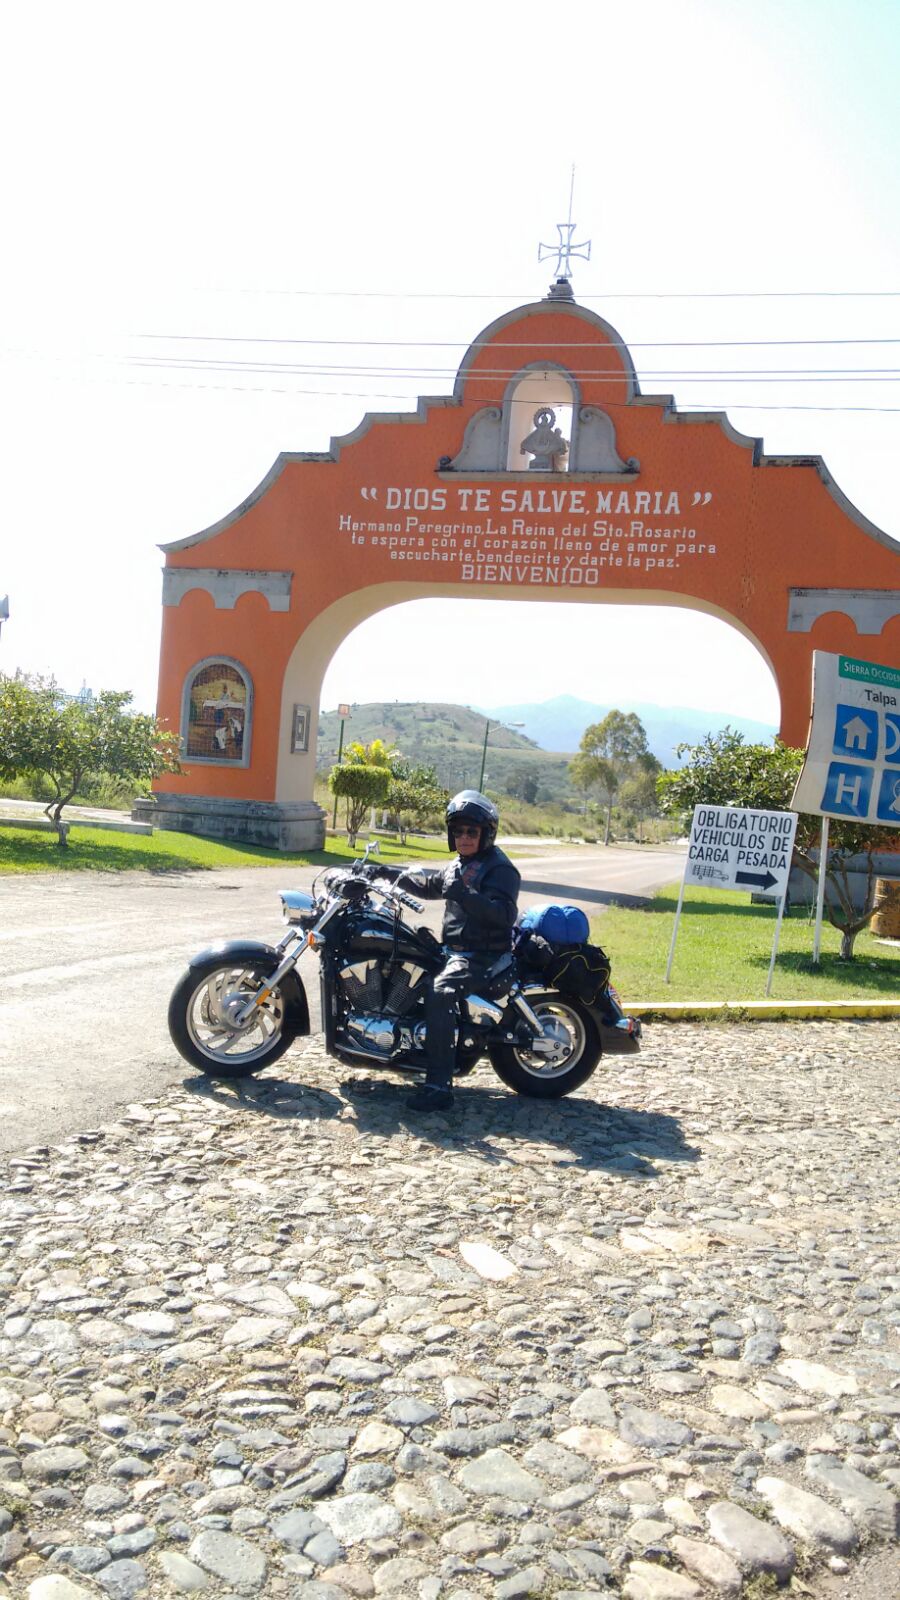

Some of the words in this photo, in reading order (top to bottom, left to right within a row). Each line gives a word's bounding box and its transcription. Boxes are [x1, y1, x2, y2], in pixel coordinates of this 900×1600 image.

[458, 488, 491, 512] TE
[500, 489, 590, 515] SALVE,
[338, 514, 401, 533] Hermano
[511, 519, 555, 537] Reina
[561, 523, 587, 537] del
[351, 532, 365, 545] te
[371, 535, 425, 549] espera
[431, 537, 457, 548] con
[463, 535, 477, 548] el
[484, 537, 547, 550] corazón
[554, 537, 593, 551] lleno
[599, 538, 620, 551] de
[627, 542, 668, 553] amor
[675, 543, 717, 557] para
[565, 554, 575, 569] y
[579, 552, 622, 567] darte
[627, 553, 641, 567] la
[461, 564, 599, 585] BIENVENIDO
[864, 689, 897, 707] Talpa
[697, 810, 793, 834] OBLIGATORIO
[693, 828, 766, 850] VEHICULOS
[771, 836, 790, 853] DE
[689, 845, 729, 863] CARGA
[736, 850, 787, 869] PESADA
